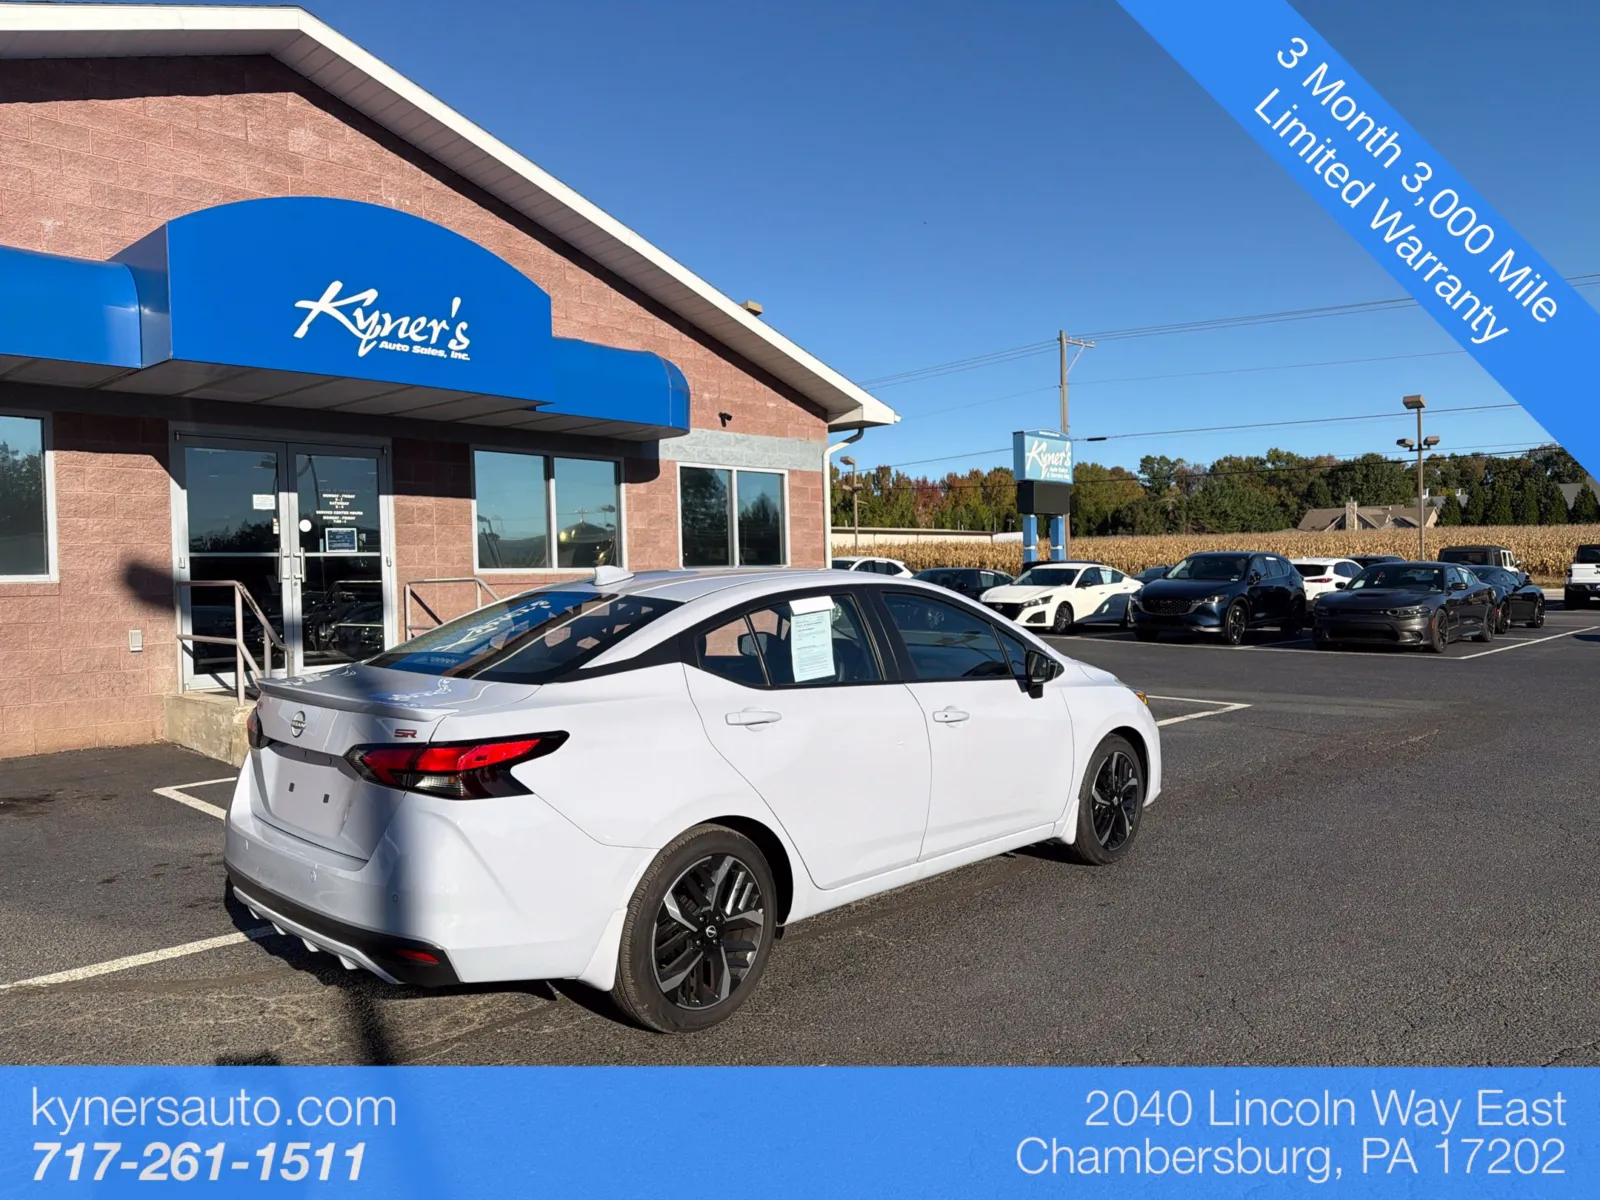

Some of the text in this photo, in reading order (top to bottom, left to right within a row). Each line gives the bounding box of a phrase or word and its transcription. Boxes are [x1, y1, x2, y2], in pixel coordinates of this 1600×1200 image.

[293, 280, 470, 357] Kyner's
[378, 340, 470, 361] Auto Sales, Inc.
[1026, 439, 1072, 480] Kyner's
[394, 728, 418, 739] SR
